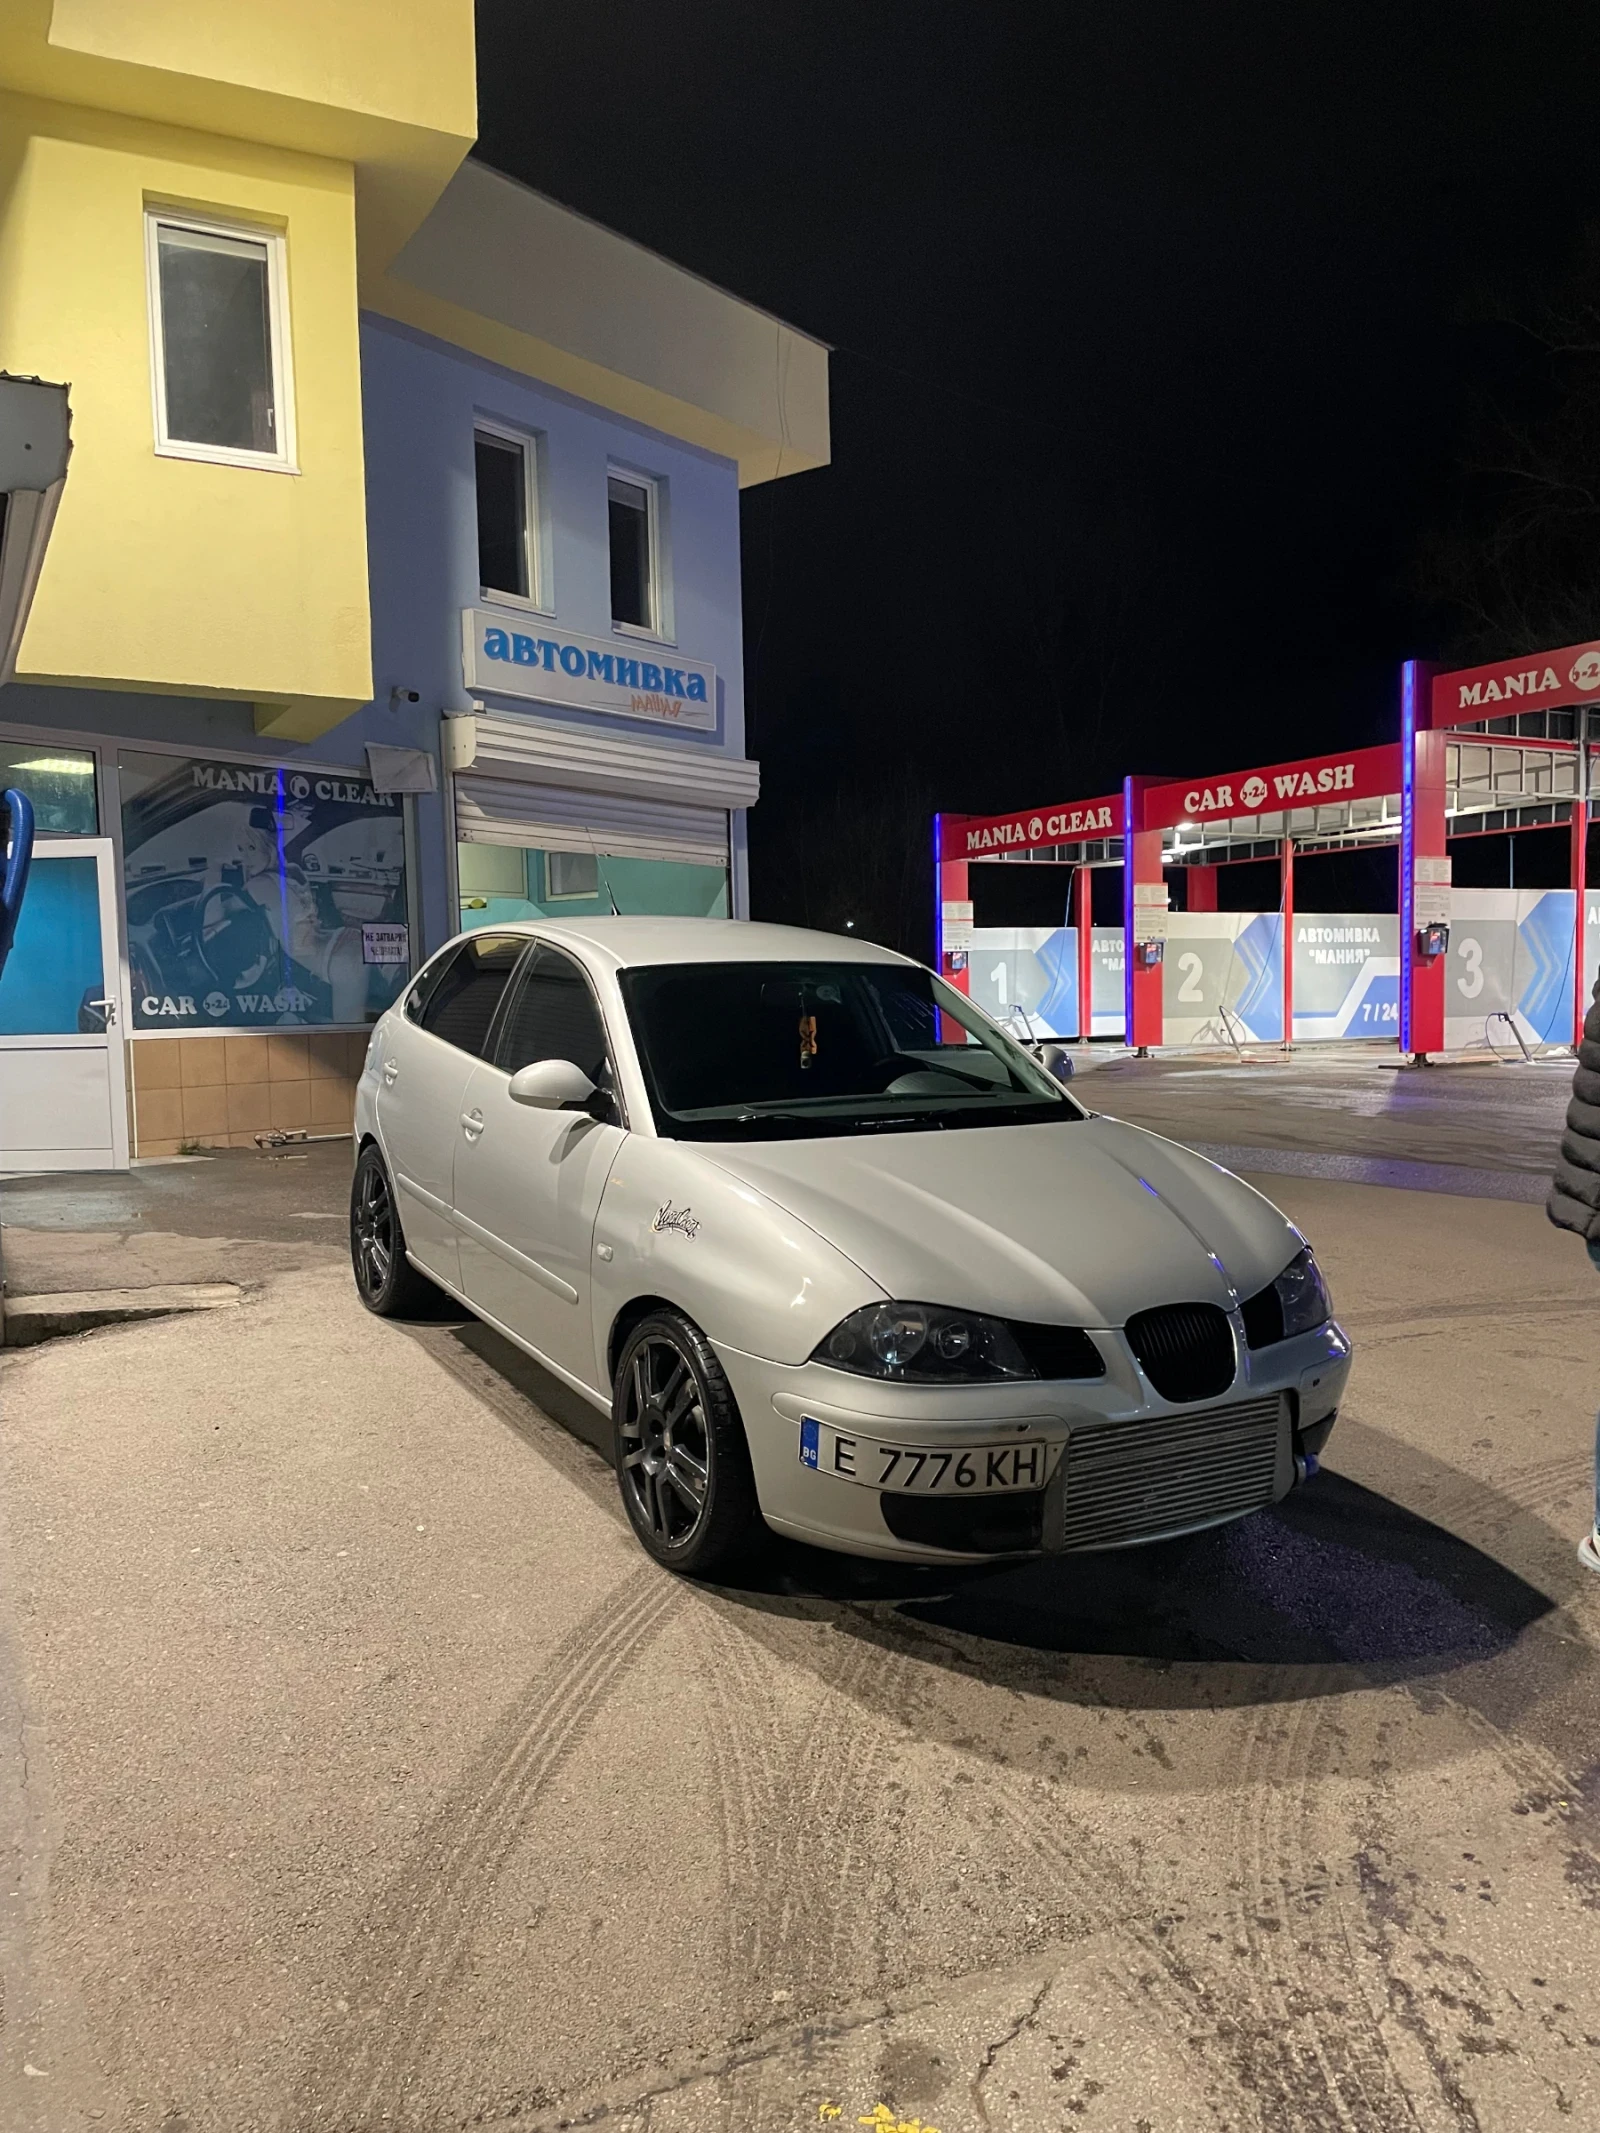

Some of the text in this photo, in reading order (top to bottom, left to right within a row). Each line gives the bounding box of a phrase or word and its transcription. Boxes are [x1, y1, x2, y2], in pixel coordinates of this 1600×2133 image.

[484, 627, 708, 702] автомивка
[1459, 667, 1562, 708] MANIA
[192, 766, 287, 796] MANIA
[1184, 785, 1234, 813] CAR
[1273, 764, 1355, 799] WASH
[967, 806, 1113, 850] MANIA CLEAR
[1297, 927, 1380, 943] АВТОМИВКА
[1308, 948, 1371, 964] "МАНИЯ"
[990, 962, 1007, 1004] 1
[1177, 952, 1204, 1002] 2
[1457, 938, 1484, 999] 3
[141, 996, 197, 1016] CAR
[236, 995, 306, 1014] WASH
[802, 1446, 817, 1460] BG
[834, 1434, 1038, 1489] E 7776 KH
